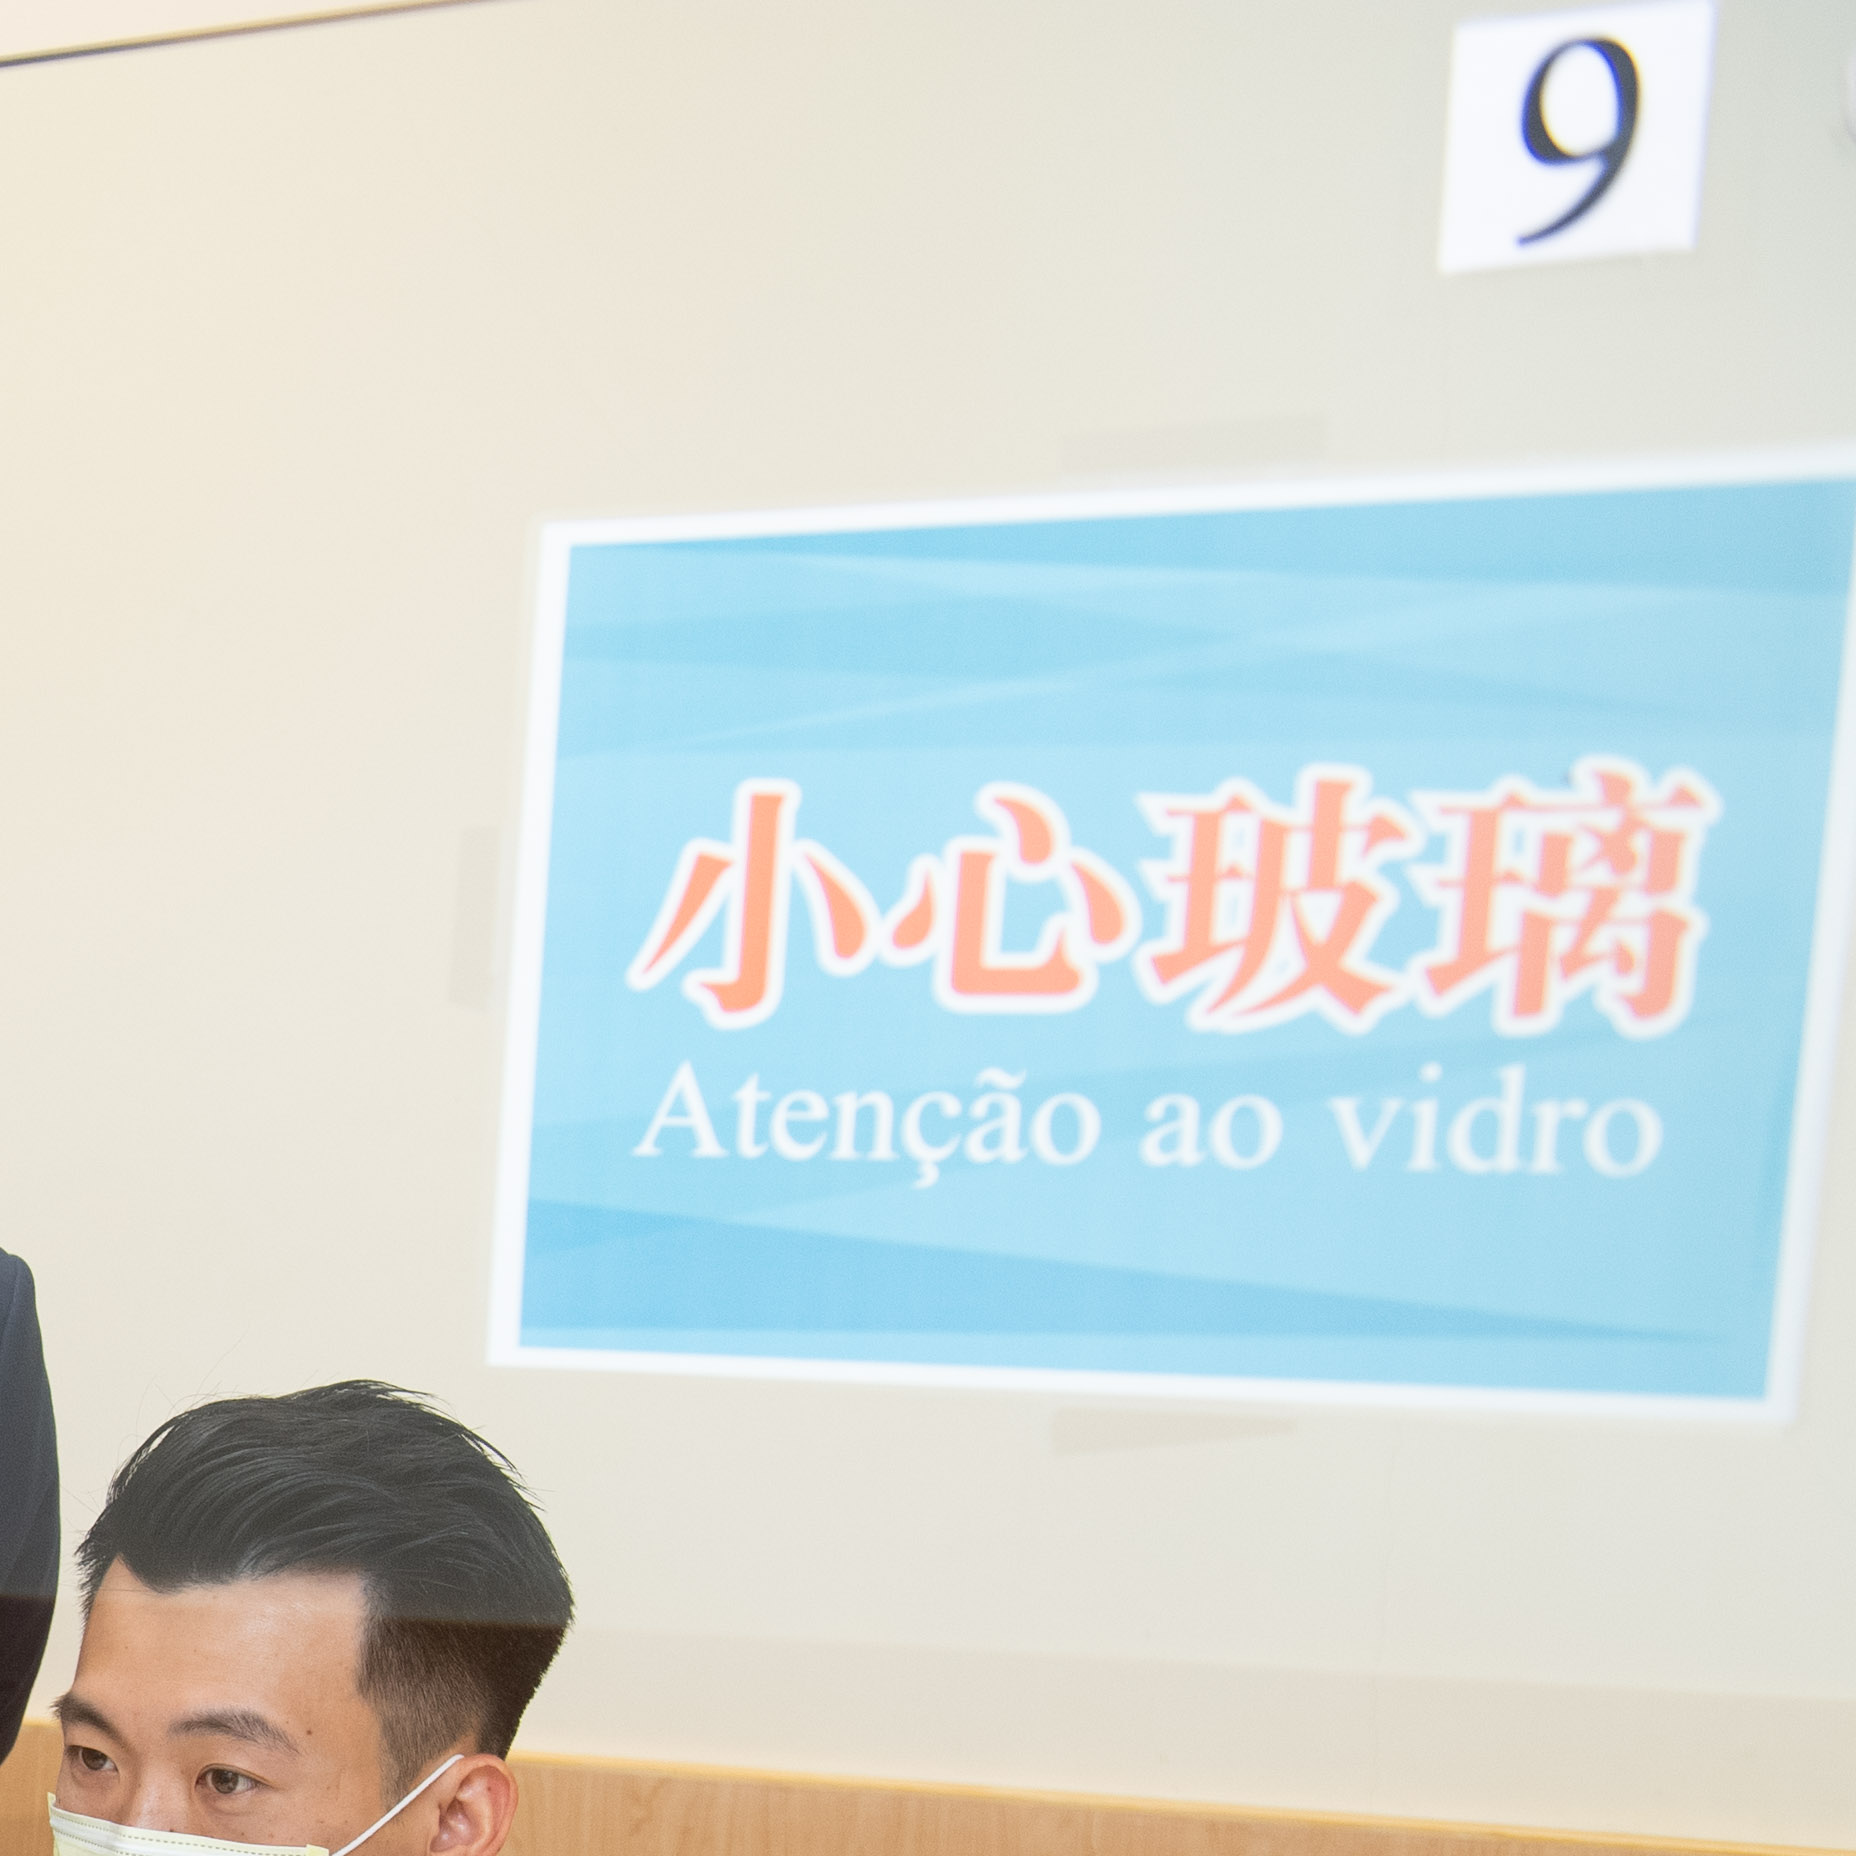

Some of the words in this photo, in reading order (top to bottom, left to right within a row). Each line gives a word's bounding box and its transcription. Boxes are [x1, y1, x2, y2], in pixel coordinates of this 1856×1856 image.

[1516, 36, 1641, 249] 9
[638, 765, 1710, 1026] 小心玻璃
[633, 1060, 1102, 1187] Atenção
[1139, 1092, 1283, 1170] ao
[1330, 1062, 1665, 1178] vidro
